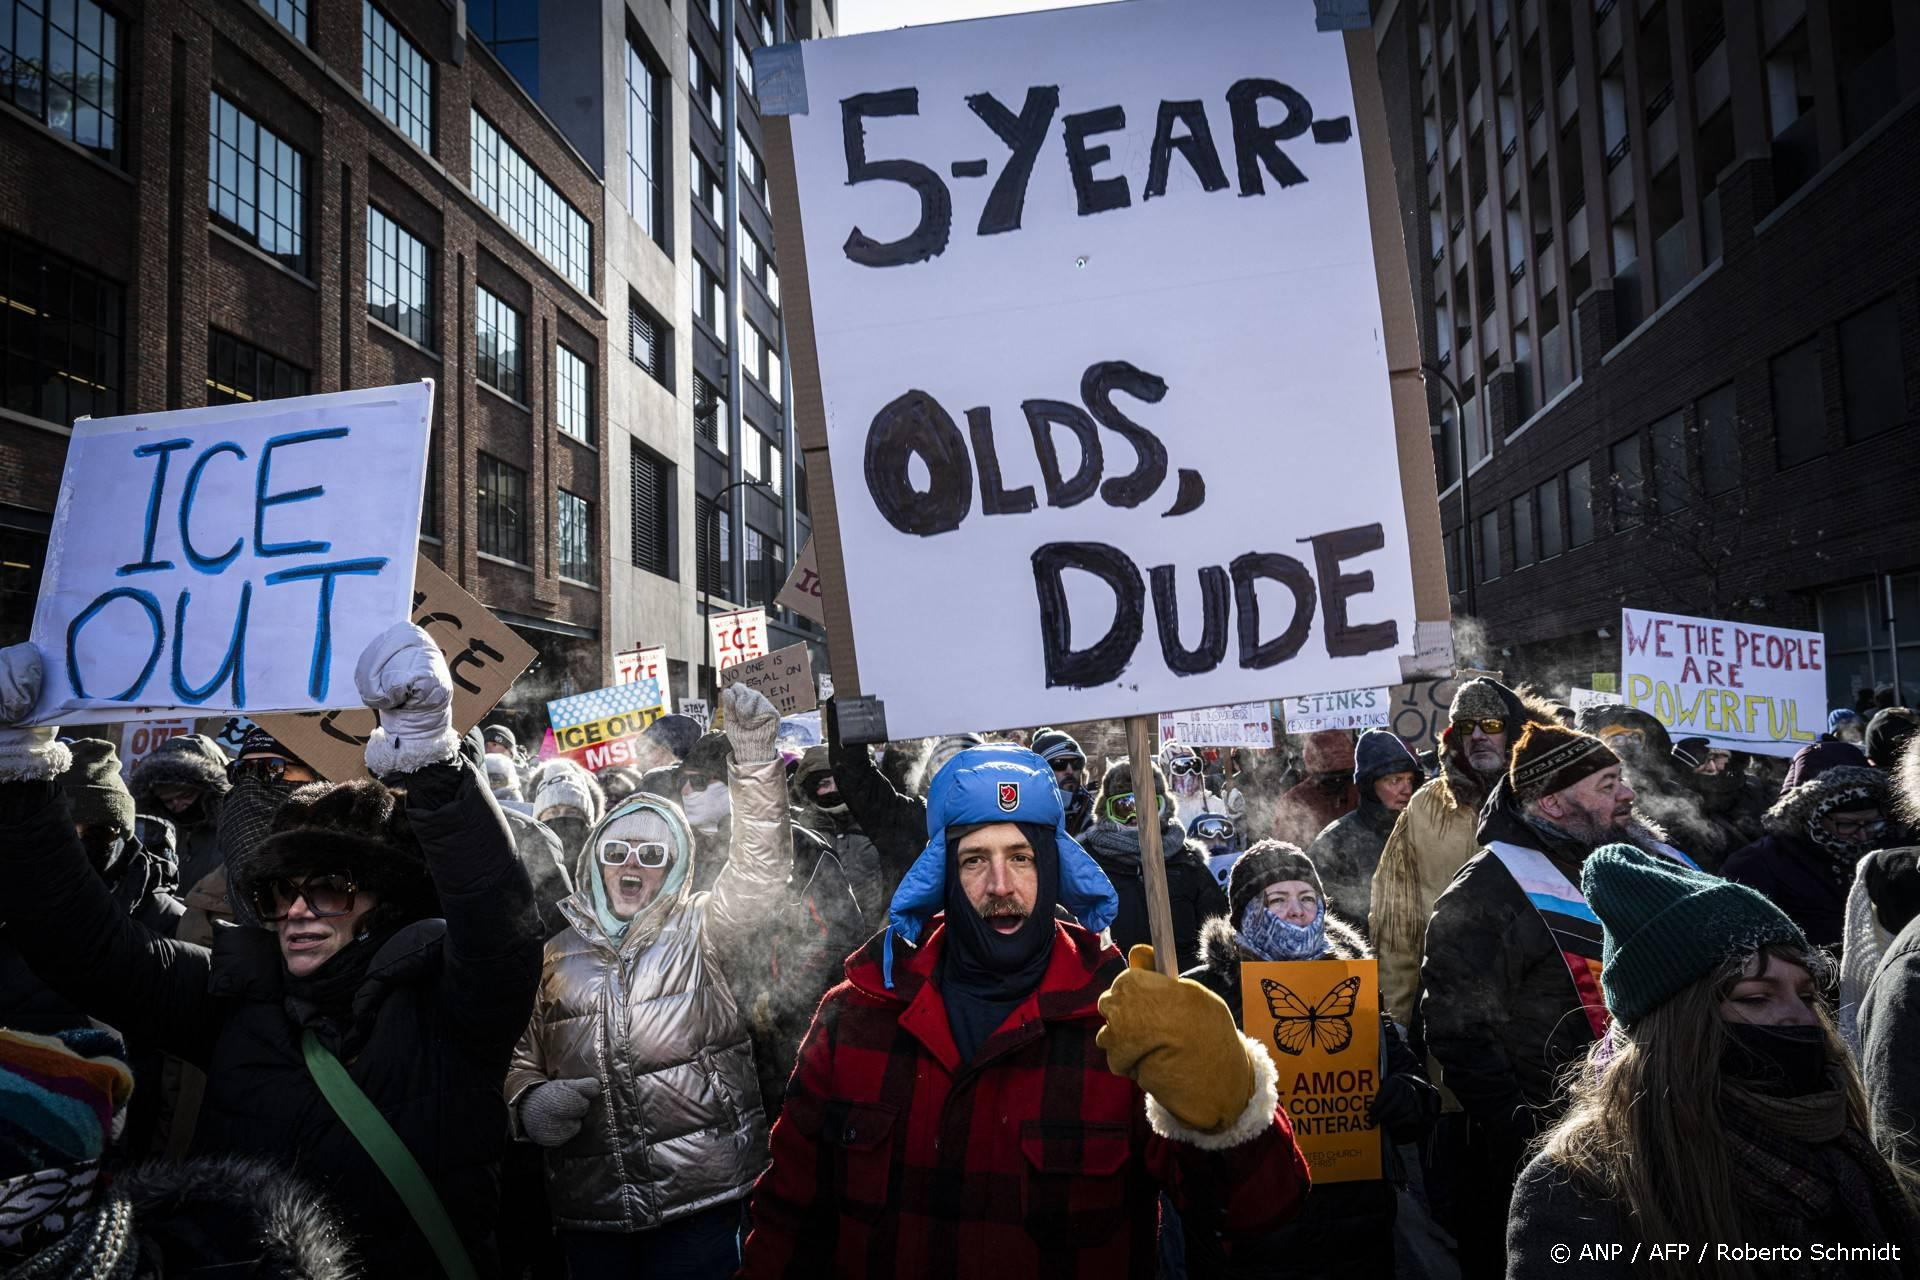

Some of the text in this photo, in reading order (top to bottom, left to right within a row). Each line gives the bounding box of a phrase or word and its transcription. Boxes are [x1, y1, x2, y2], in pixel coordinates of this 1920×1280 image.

[840, 78, 1352, 267] 5-YEAR-
[864, 360, 1205, 537] OLDS,
[116, 426, 351, 577] ICE
[1031, 522, 1400, 689] DUDE
[66, 556, 391, 709] OUT
[718, 626, 759, 652] ICE
[1624, 612, 1822, 670] WE THE PEOPLE
[721, 655, 783, 683] NO ONE IS
[786, 664, 801, 676] ON
[1680, 657, 1744, 688] ARE
[761, 683, 790, 699] LEN
[1297, 691, 1376, 714] STINKS
[683, 704, 705, 714] STAY
[1628, 673, 1816, 741] POWERFUL
[554, 707, 661, 751] ICE OUT
[1333, 717, 1345, 727] IN
[1292, 1069, 1374, 1096] AMOR
[1289, 1094, 1375, 1115] CONOCE
[1292, 1113, 1376, 1136] NTERAS
